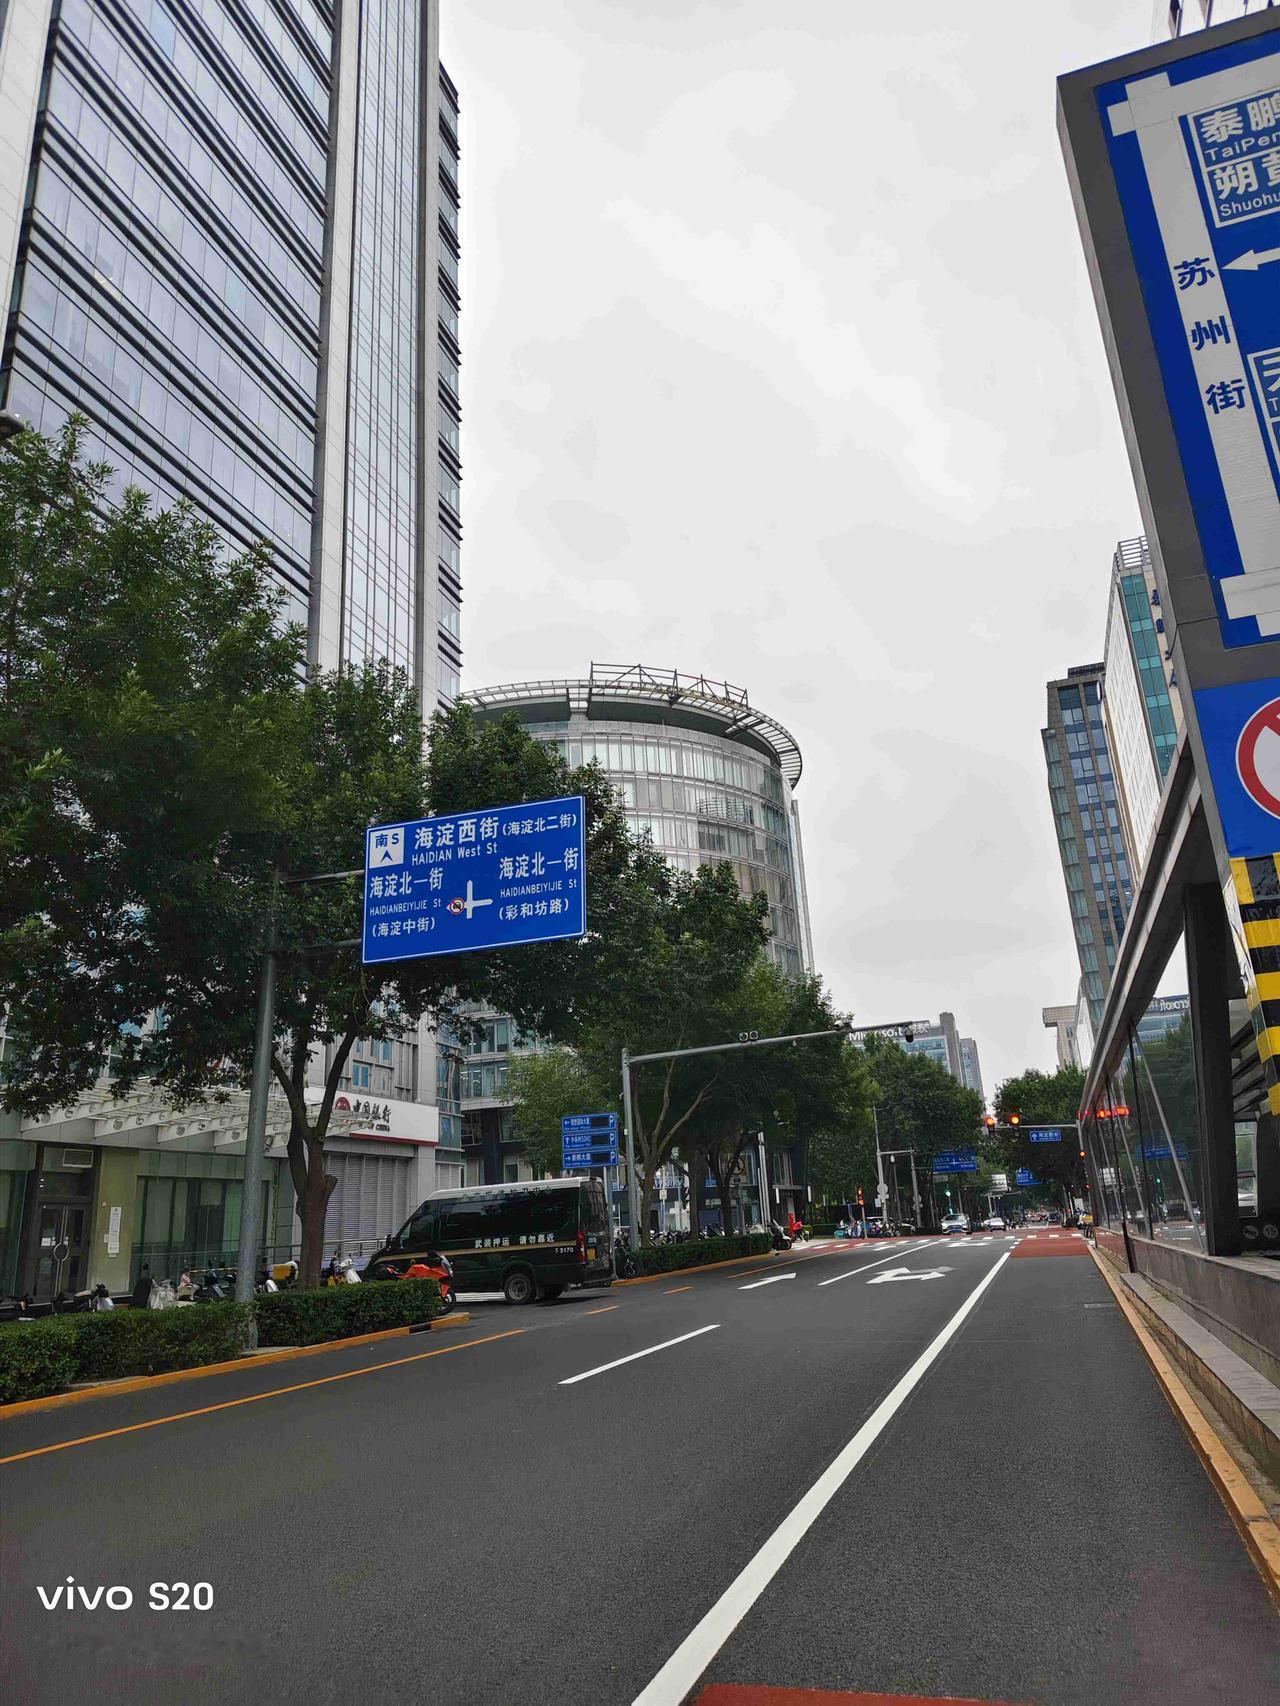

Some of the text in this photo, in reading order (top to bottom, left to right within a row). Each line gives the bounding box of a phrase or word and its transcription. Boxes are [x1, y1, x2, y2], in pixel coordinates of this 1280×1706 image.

[1173, 256, 1248, 415] 苏州街
[375, 833, 388, 848] 南
[391, 832, 400, 845] S
[414, 812, 577, 850] 海淀西街 (海淀北二街)
[411, 841, 498, 866] HAIDIAN West St
[499, 847, 579, 880] 海淀北一街
[369, 866, 444, 899] 海淀北一街
[500, 878, 578, 899] HAIDIANBEIYIJIE St
[369, 898, 442, 917] HAIDIANBEIYIJIE St
[498, 898, 570, 921] (彩和坊路)
[371, 916, 437, 938] (海淀中街)
[849, 1026, 903, 1041] Miosoft
